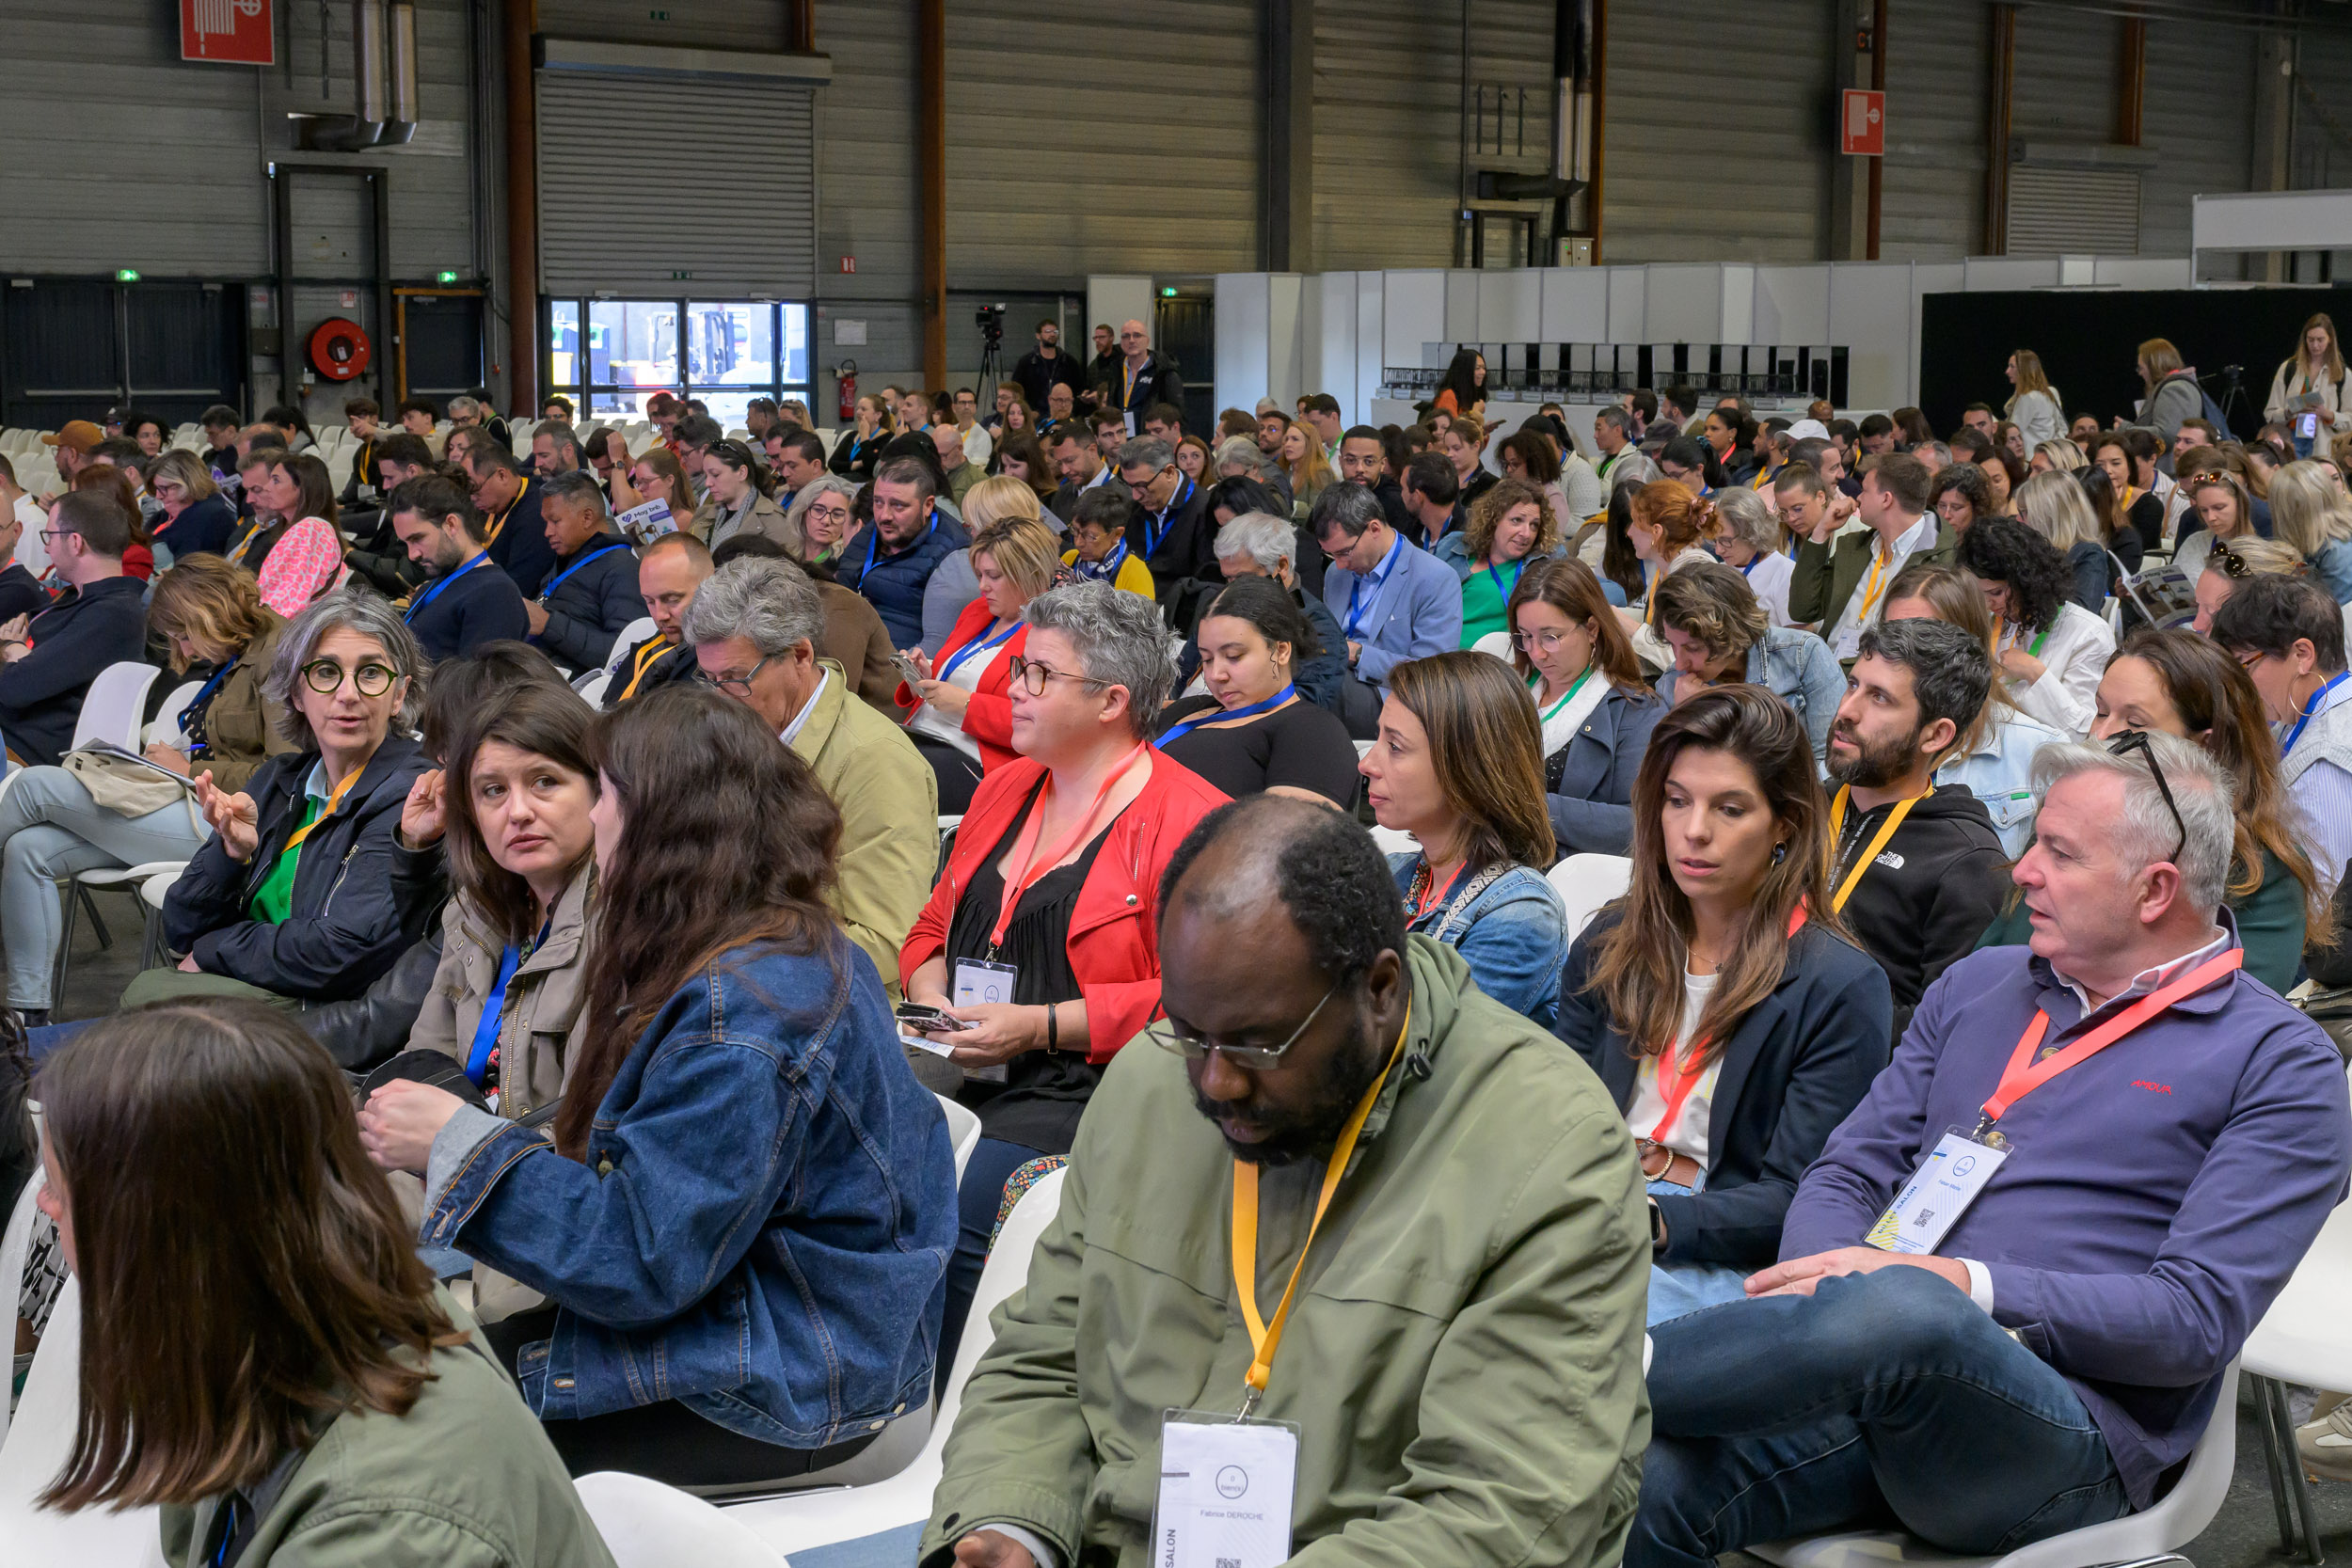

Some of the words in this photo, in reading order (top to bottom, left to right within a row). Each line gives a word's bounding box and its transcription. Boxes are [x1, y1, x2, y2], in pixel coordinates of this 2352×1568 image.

[2130, 1079, 2172, 1096] AMOUR
[1897, 1185, 1917, 1209] SALON
[1200, 1509, 1225, 1518] Fabrice
[1226, 1511, 1263, 1521] DEROCHE
[1165, 1528, 1177, 1568] SALON
